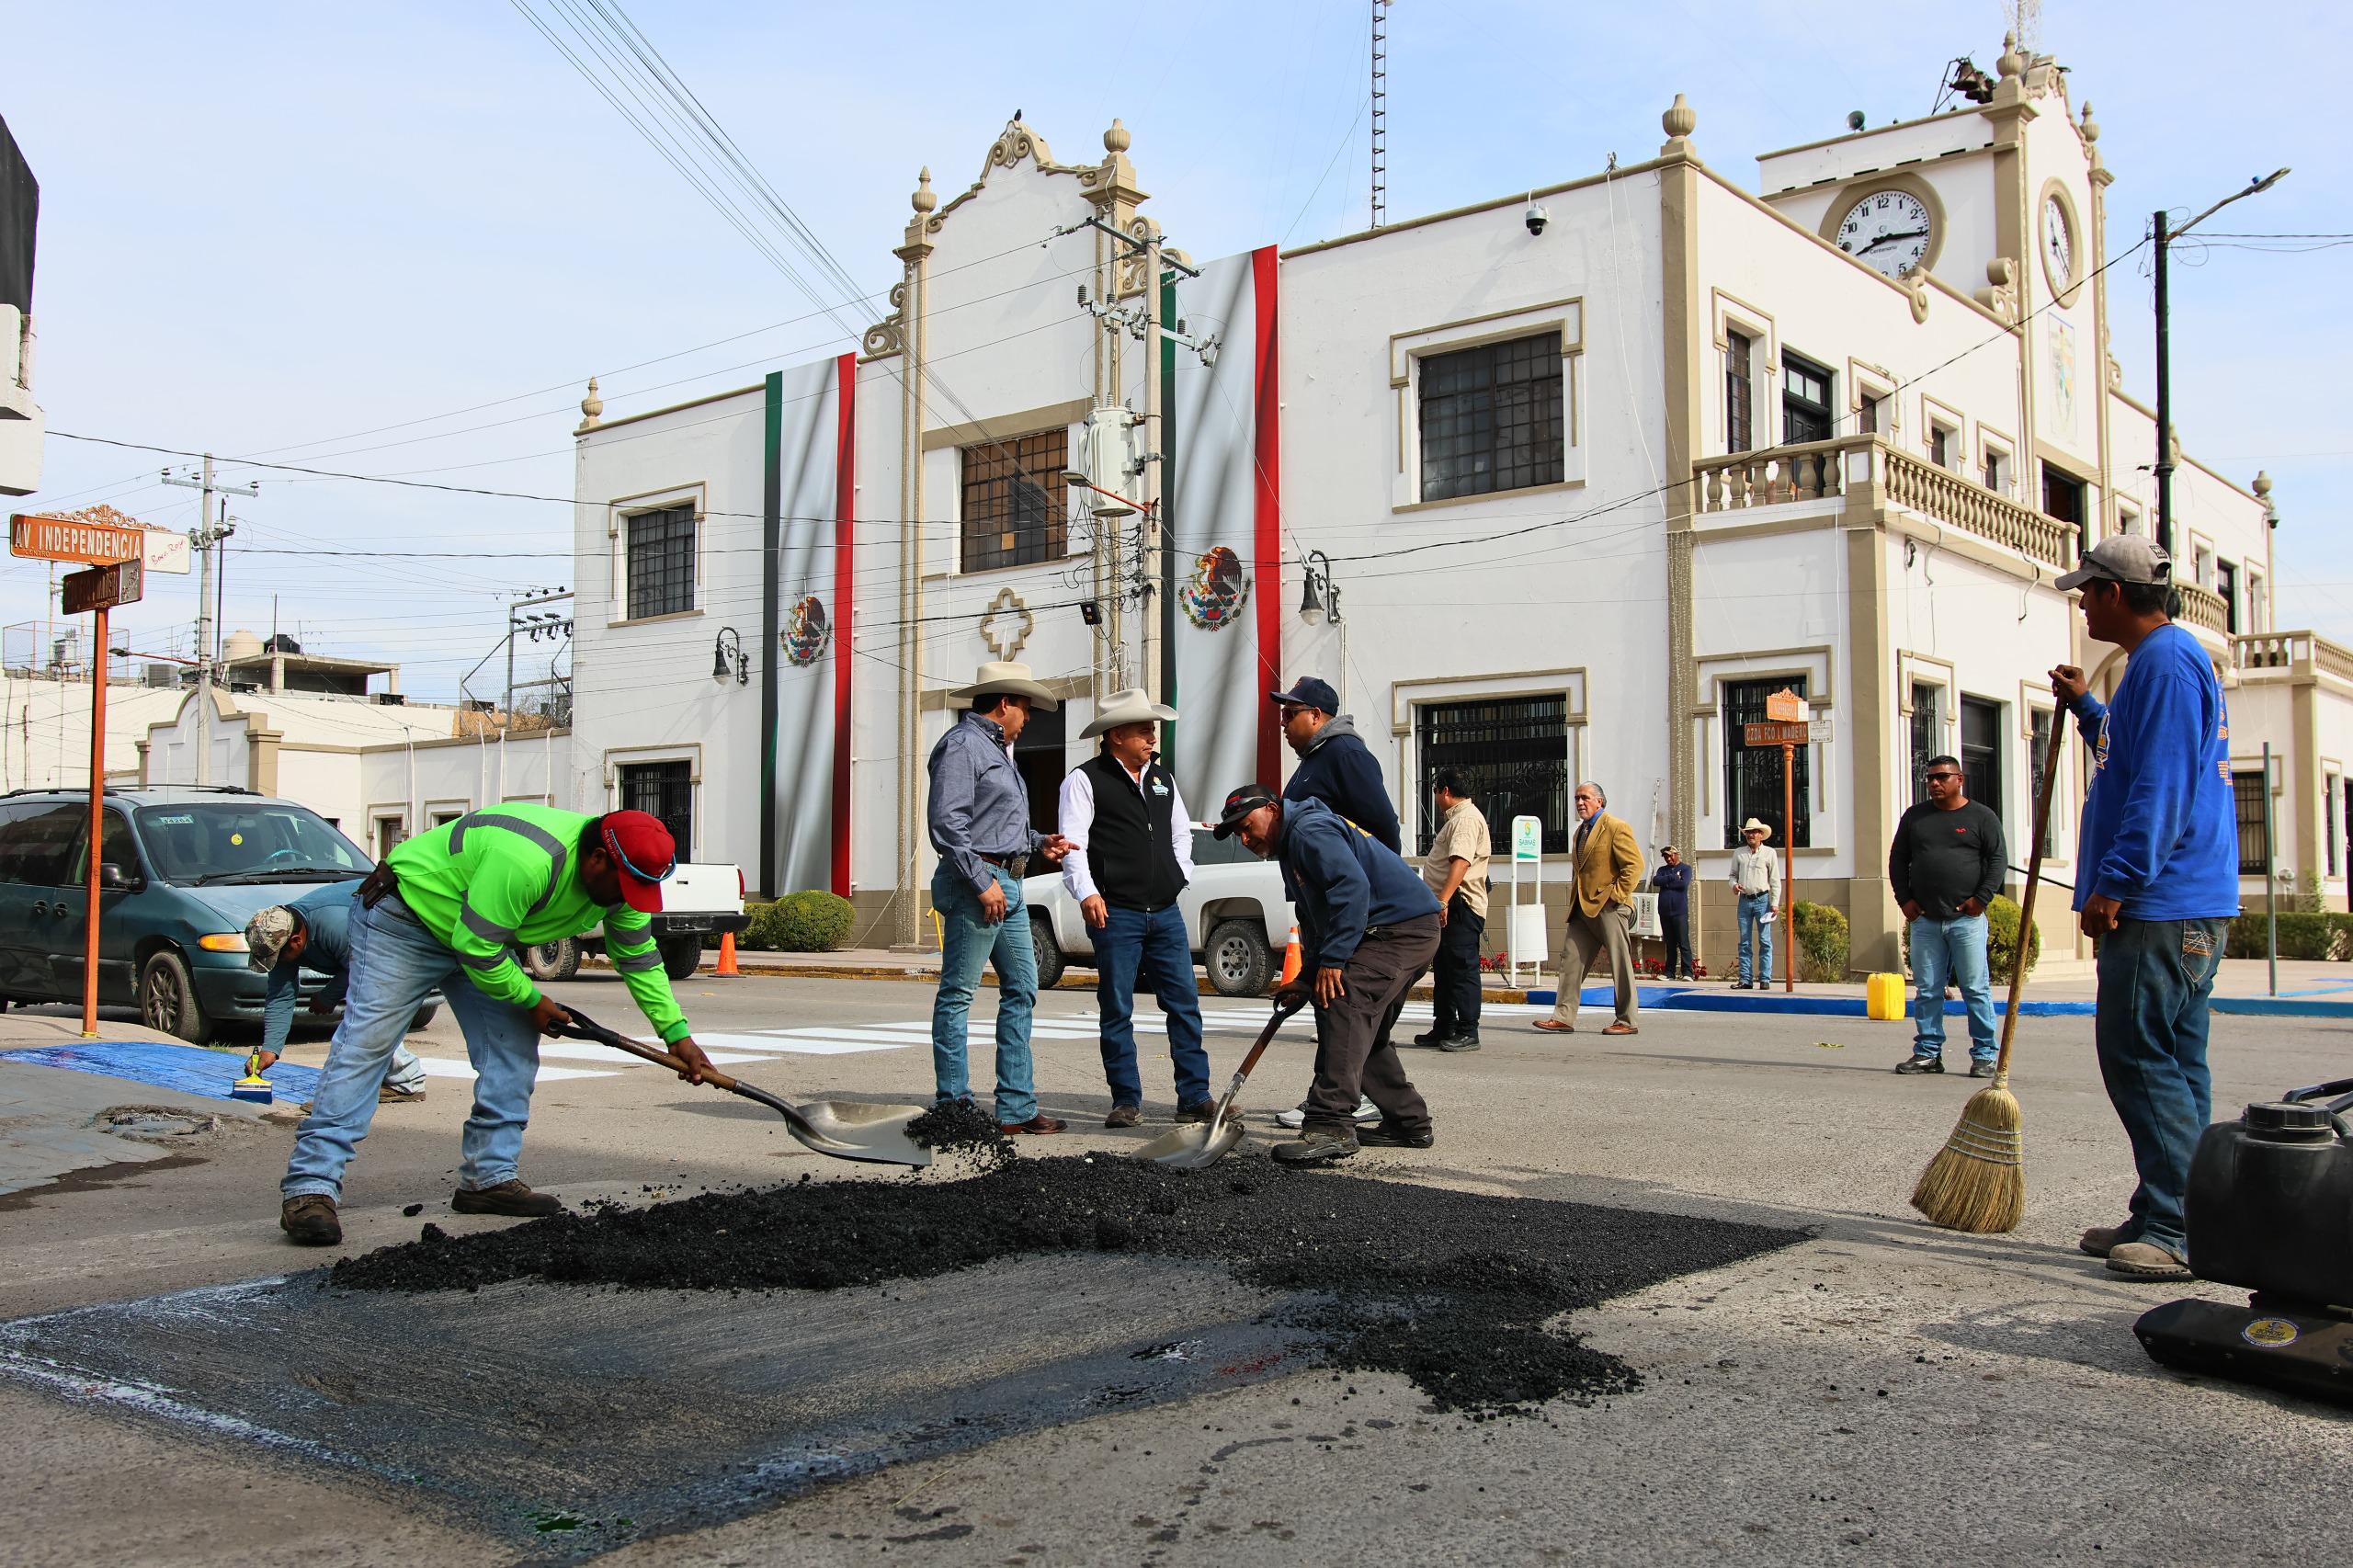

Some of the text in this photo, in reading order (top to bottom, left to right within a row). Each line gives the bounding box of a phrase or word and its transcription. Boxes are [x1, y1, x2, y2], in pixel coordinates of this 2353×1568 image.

[1877, 198, 1890, 210] 12
[1899, 199, 1903, 210] 1
[1861, 206, 1870, 217] 11
[1910, 209, 1918, 220] 2
[1847, 222, 1858, 233] 10
[1912, 246, 1919, 256] 4
[1899, 263, 1907, 273] 5
[39, 525, 142, 560] INDEPENDENCIA
[25, 550, 51, 558] CENTRO
[1746, 727, 1761, 741] CZDA
[1782, 724, 1807, 739] MADERO
